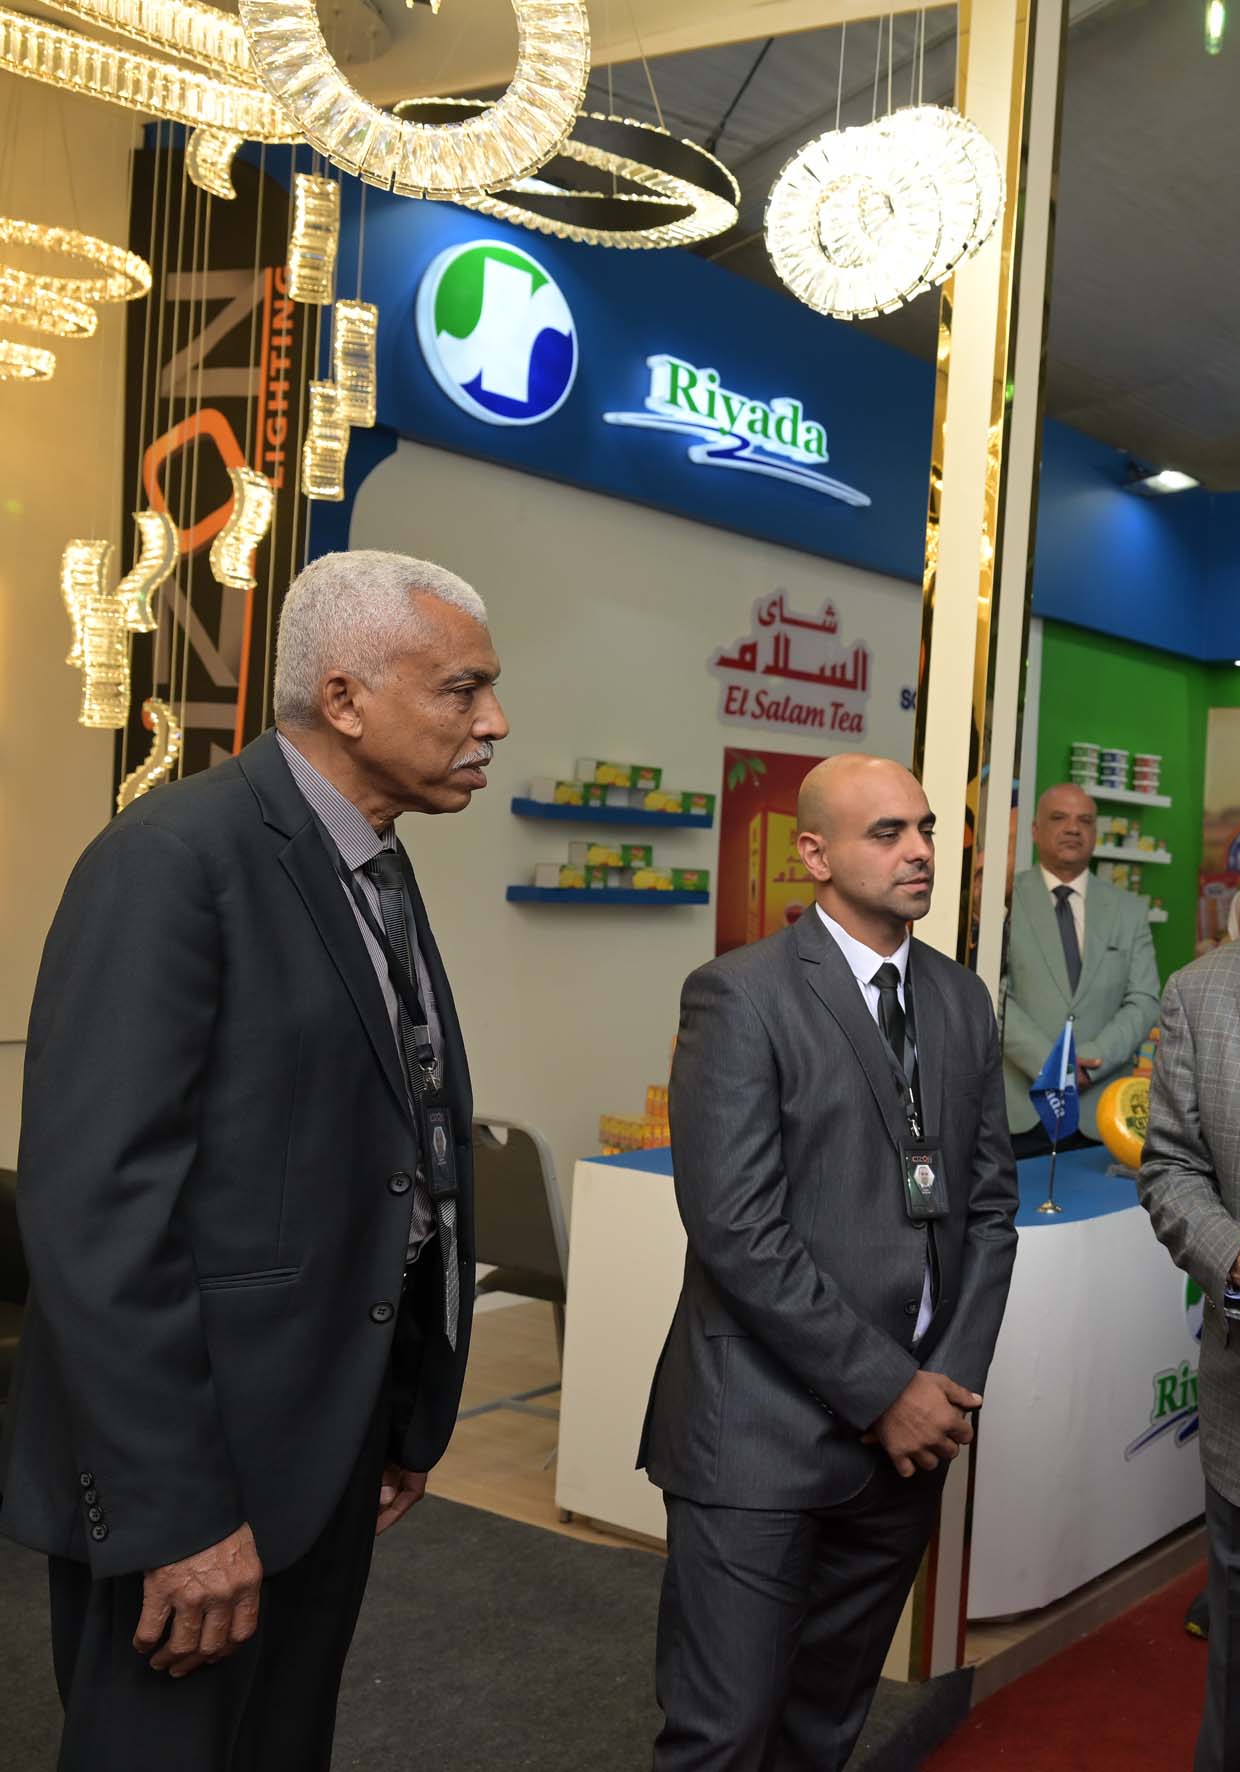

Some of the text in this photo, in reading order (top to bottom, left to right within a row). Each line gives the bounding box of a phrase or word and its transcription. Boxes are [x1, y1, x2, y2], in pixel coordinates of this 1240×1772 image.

[663, 359, 826, 459] Riyada
[724, 685, 864, 734] El Salam Tea
